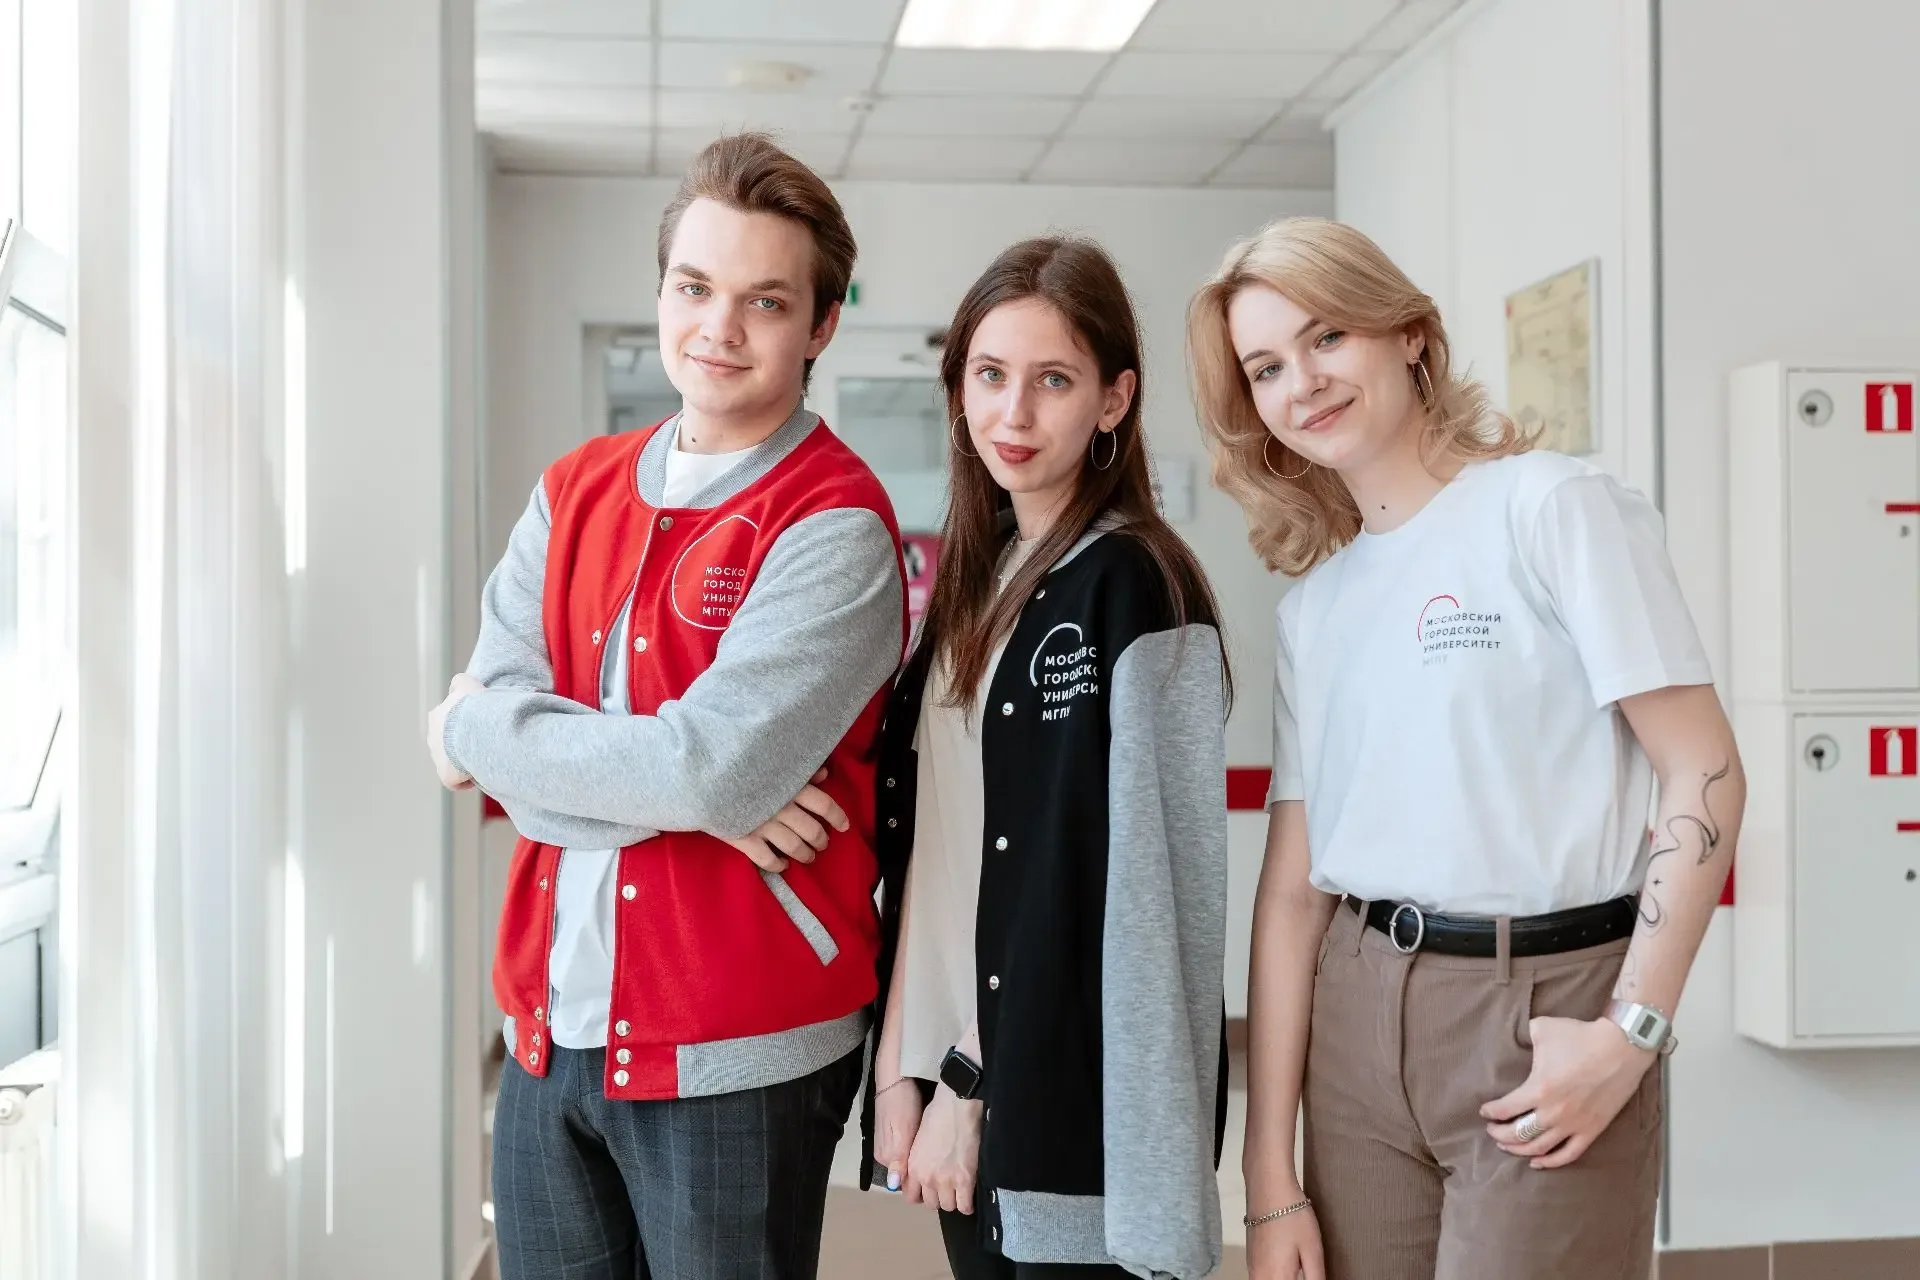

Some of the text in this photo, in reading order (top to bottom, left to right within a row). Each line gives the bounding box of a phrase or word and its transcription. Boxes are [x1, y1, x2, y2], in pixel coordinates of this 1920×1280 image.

[702, 606, 732, 617] МГПУ
[1426, 612, 1501, 627] МОСКОВСКИЙ
[1424, 626, 1489, 640] ГОРОДСКОЙ
[1423, 639, 1501, 653] УНИВЕРСИТЕТ
[1042, 705, 1071, 721] МГПУ
